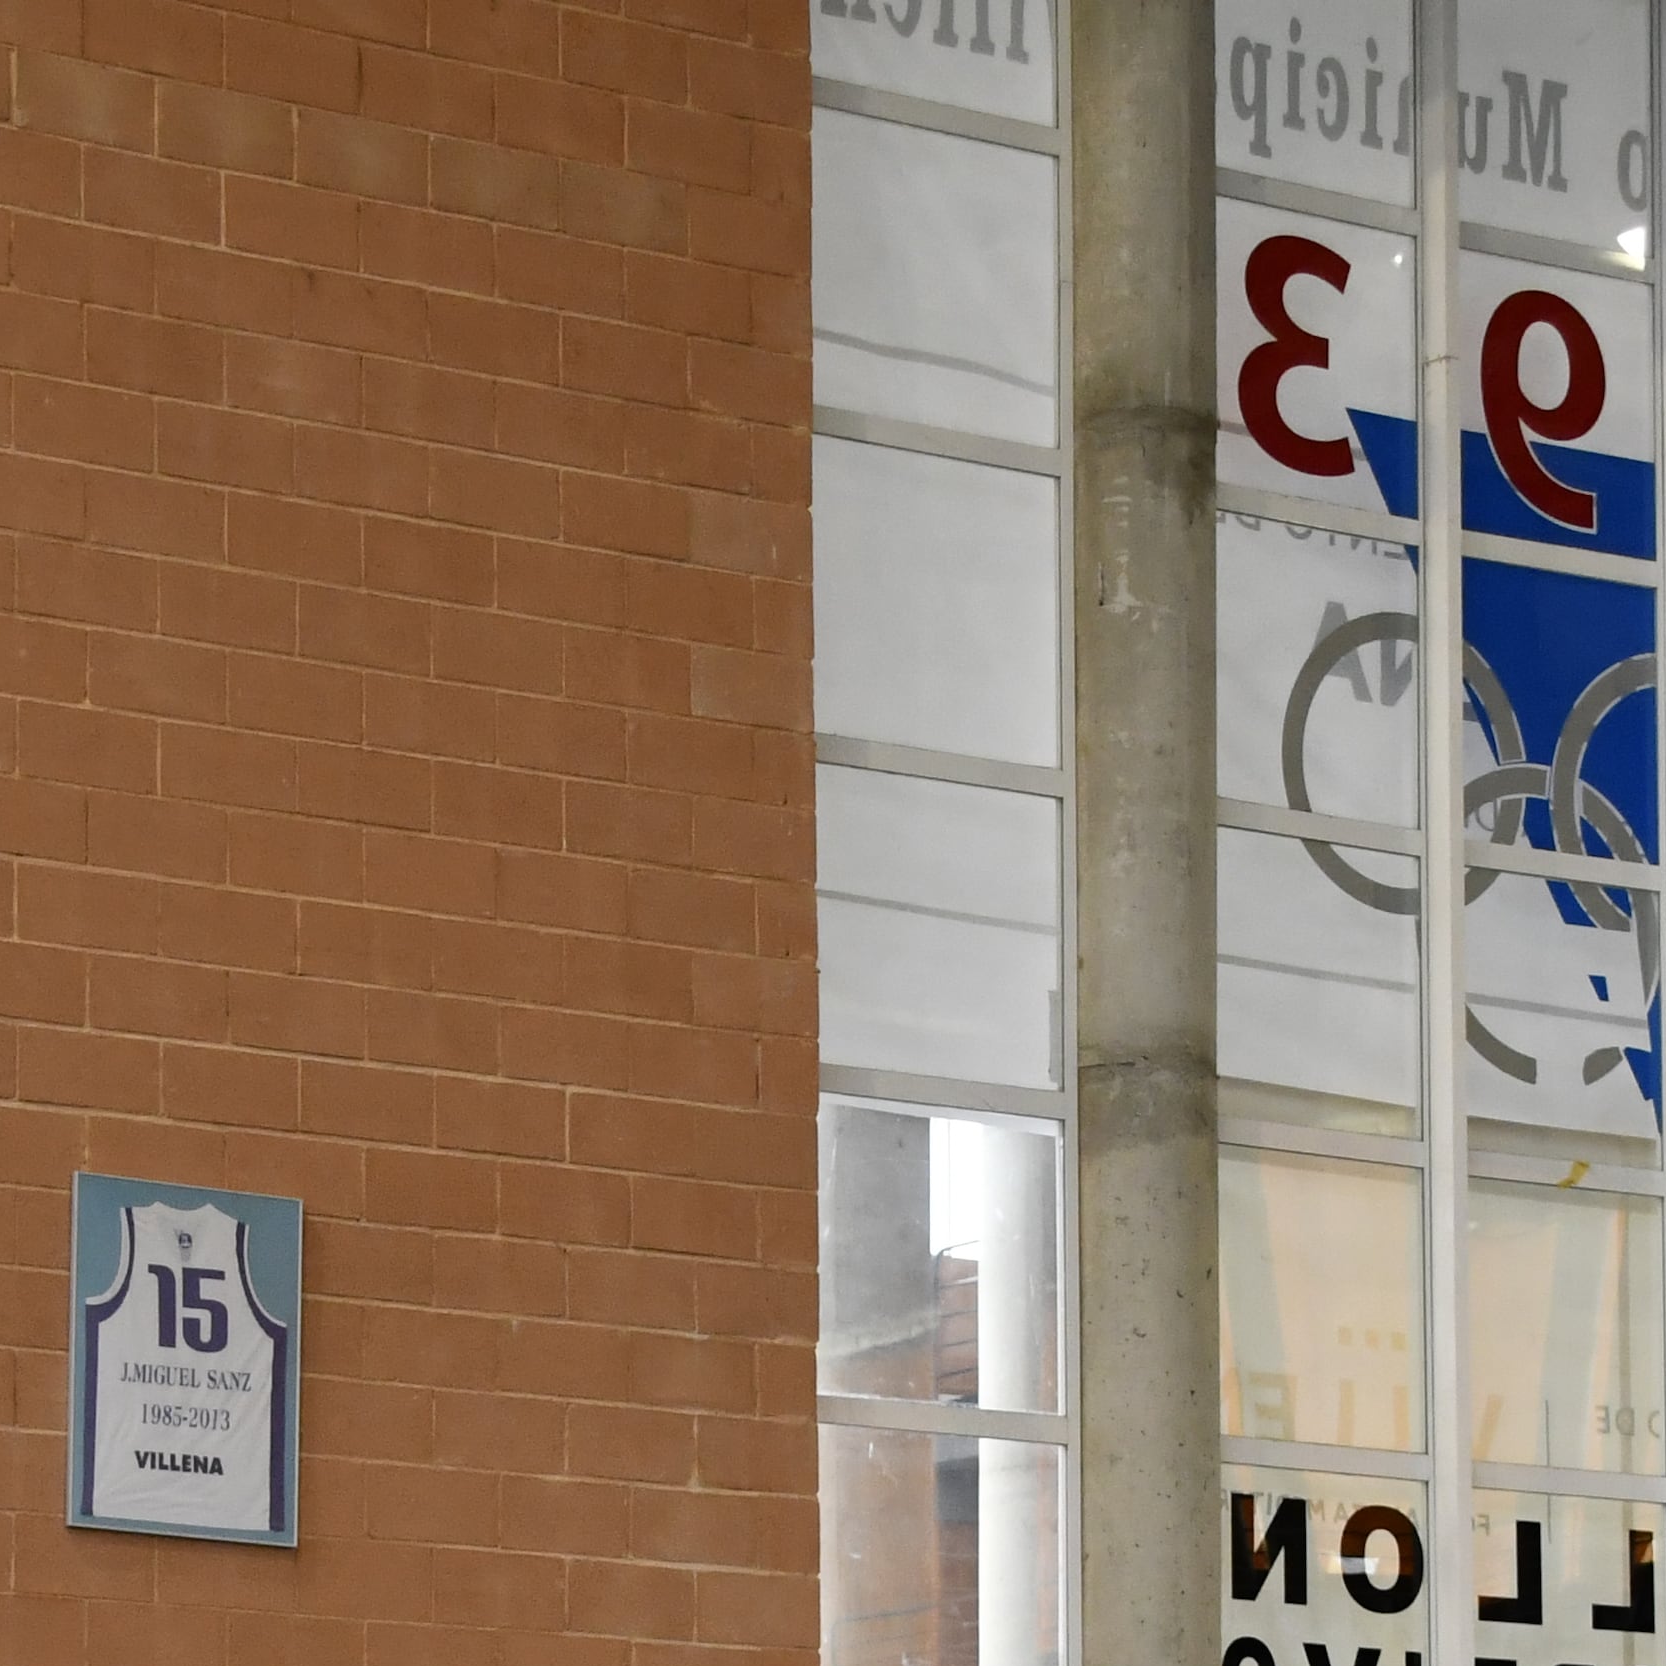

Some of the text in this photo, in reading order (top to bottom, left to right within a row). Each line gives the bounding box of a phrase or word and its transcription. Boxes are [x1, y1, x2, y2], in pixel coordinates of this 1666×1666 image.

[147, 1263, 229, 1354] 15
[120, 1361, 253, 1393] J.MIGUEL SANZ
[141, 1402, 231, 1432] 1985-2013
[134, 1449, 224, 1476] VILLENA
